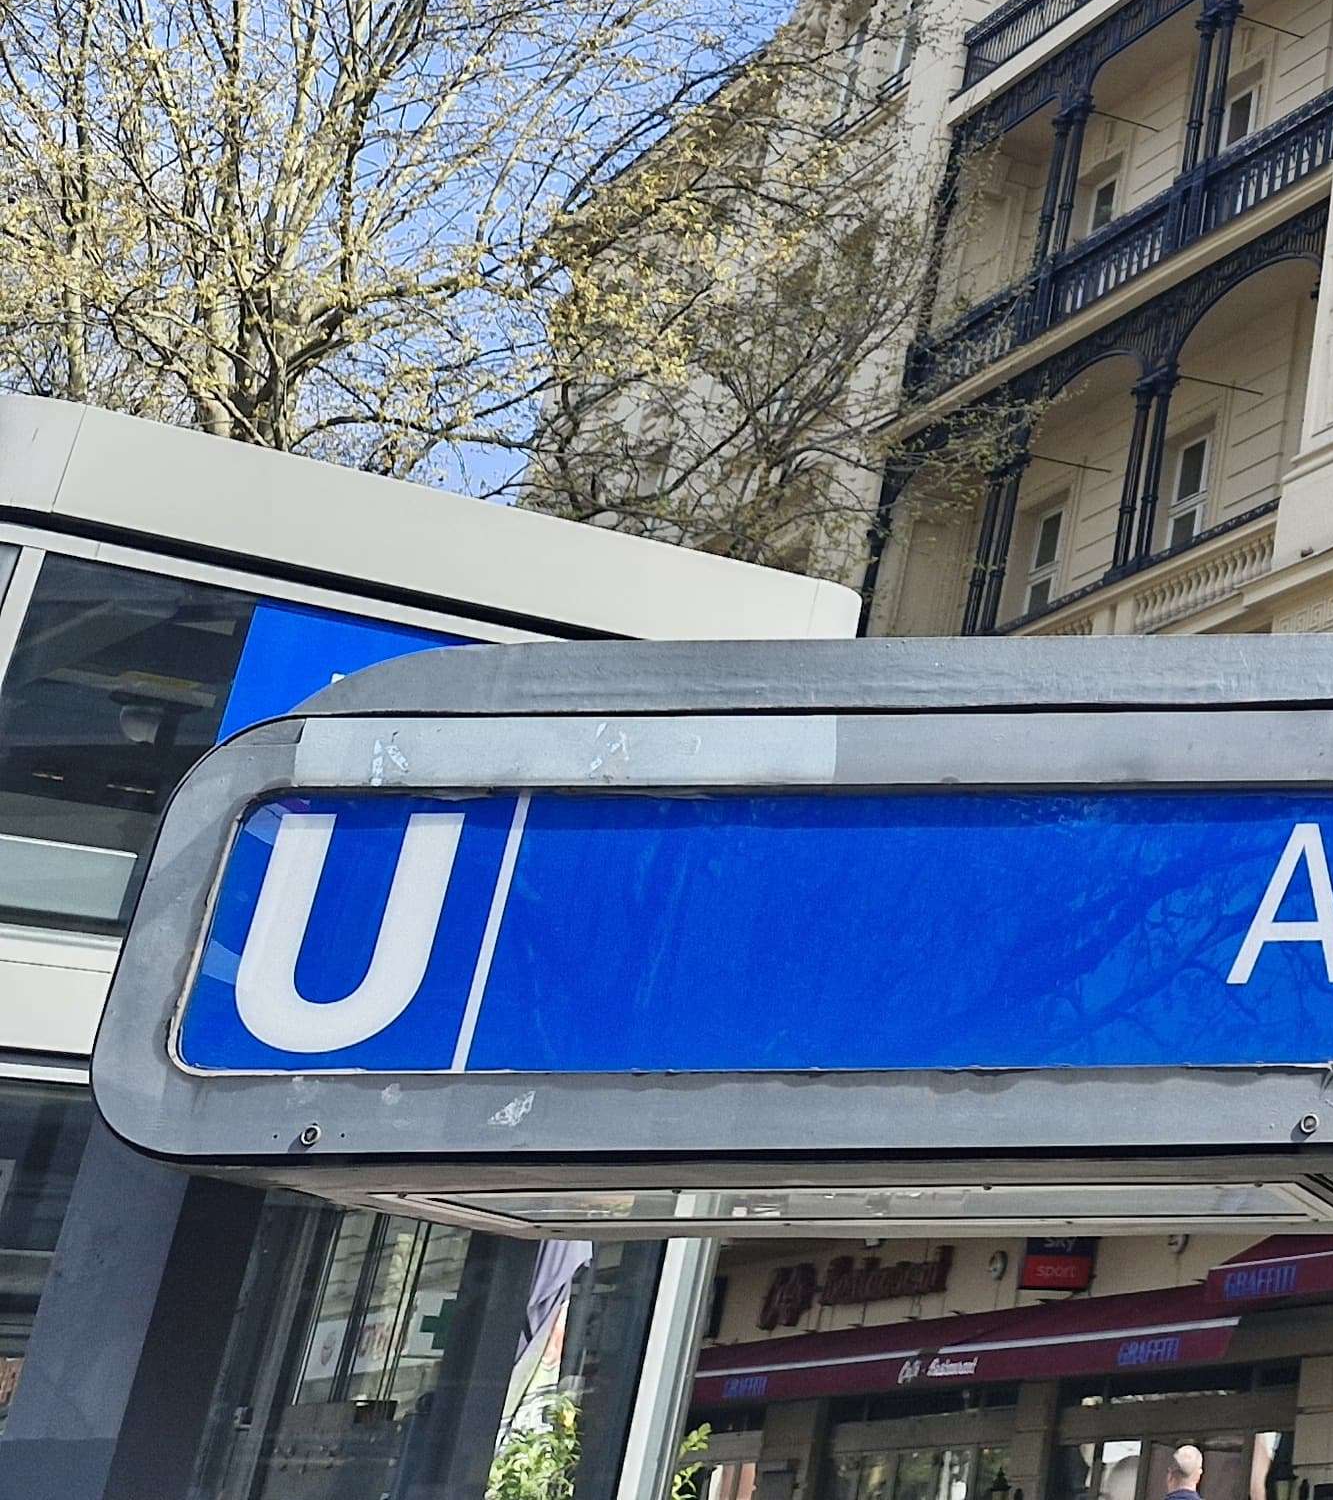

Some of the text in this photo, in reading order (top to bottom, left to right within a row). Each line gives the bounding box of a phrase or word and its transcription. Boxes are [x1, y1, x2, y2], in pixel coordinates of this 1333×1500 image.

[234, 812, 466, 1054] U
[1035, 1264, 1077, 1280] sport
[1224, 1264, 1297, 1298] GRAFFITI
[1117, 1336, 1180, 1366] GRAFFITI
